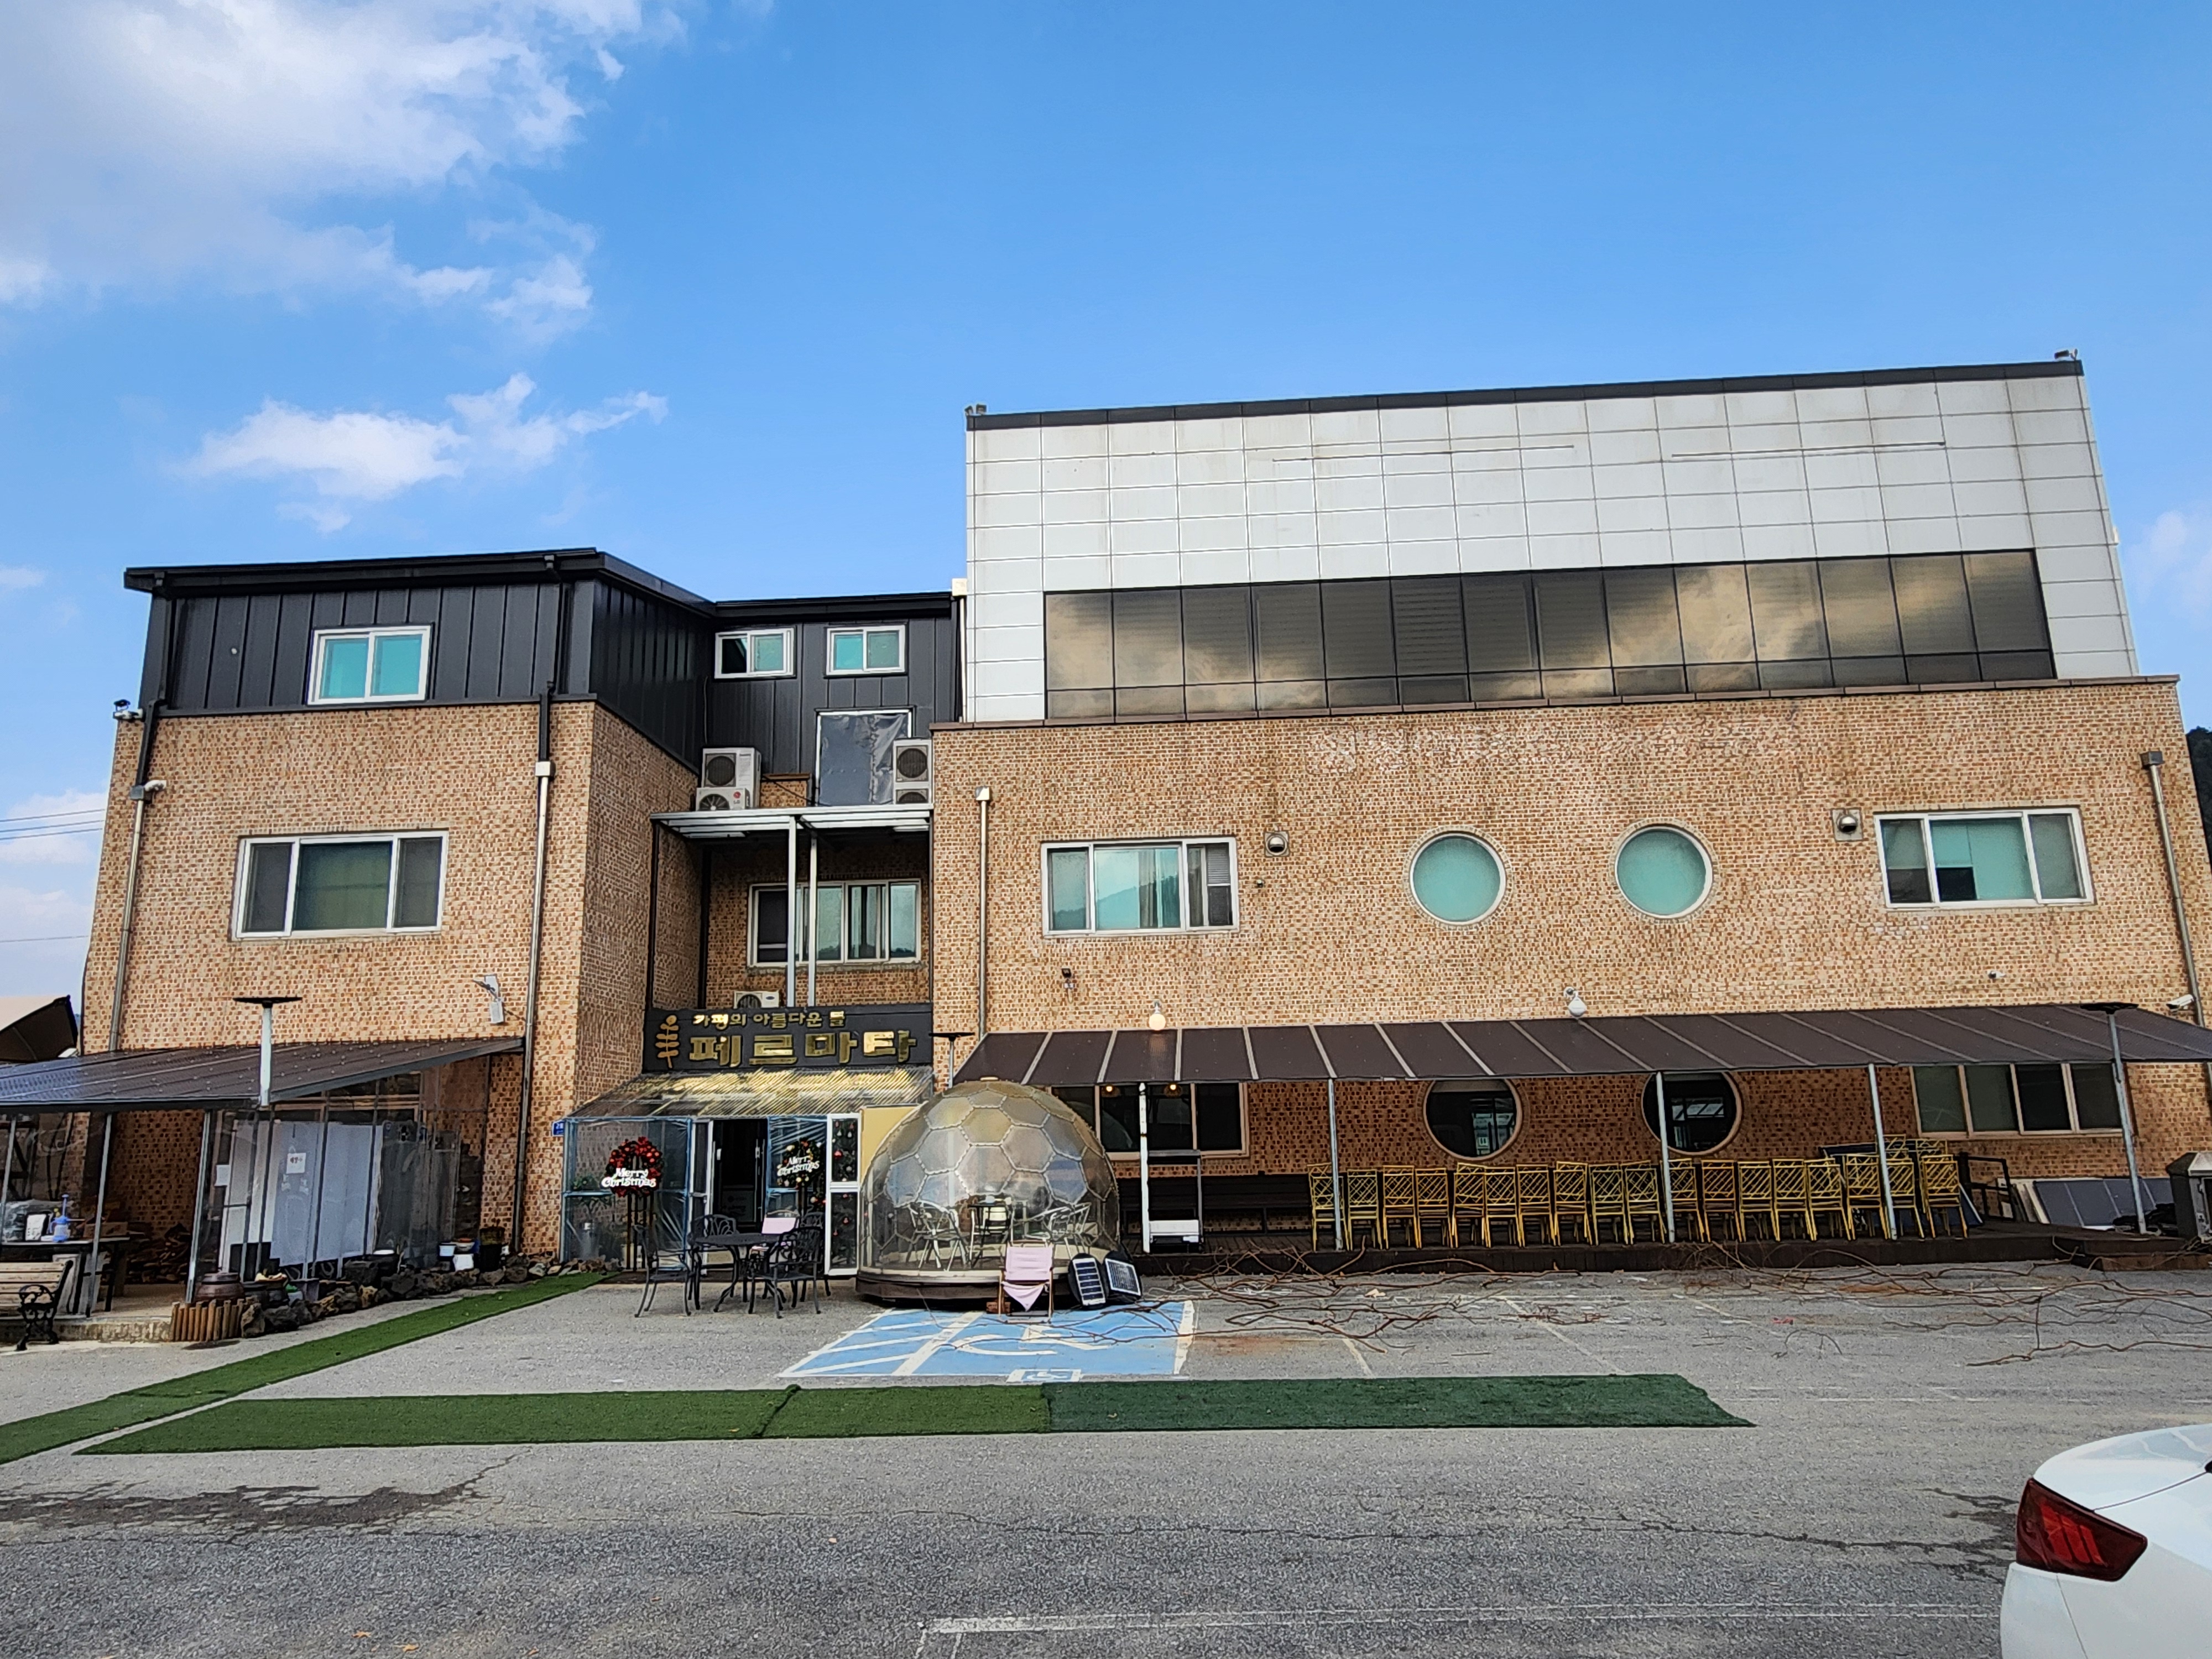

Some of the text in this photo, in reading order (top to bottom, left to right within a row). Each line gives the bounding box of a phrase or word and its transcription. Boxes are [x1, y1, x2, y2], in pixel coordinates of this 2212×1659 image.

[692, 1013, 747, 1030] 가평의
[753, 1012, 822, 1029] 아름다운
[689, 1030, 917, 1067] 페르마타
[612, 1168, 649, 1179] Merry
[601, 1177, 656, 1187] Christmas
